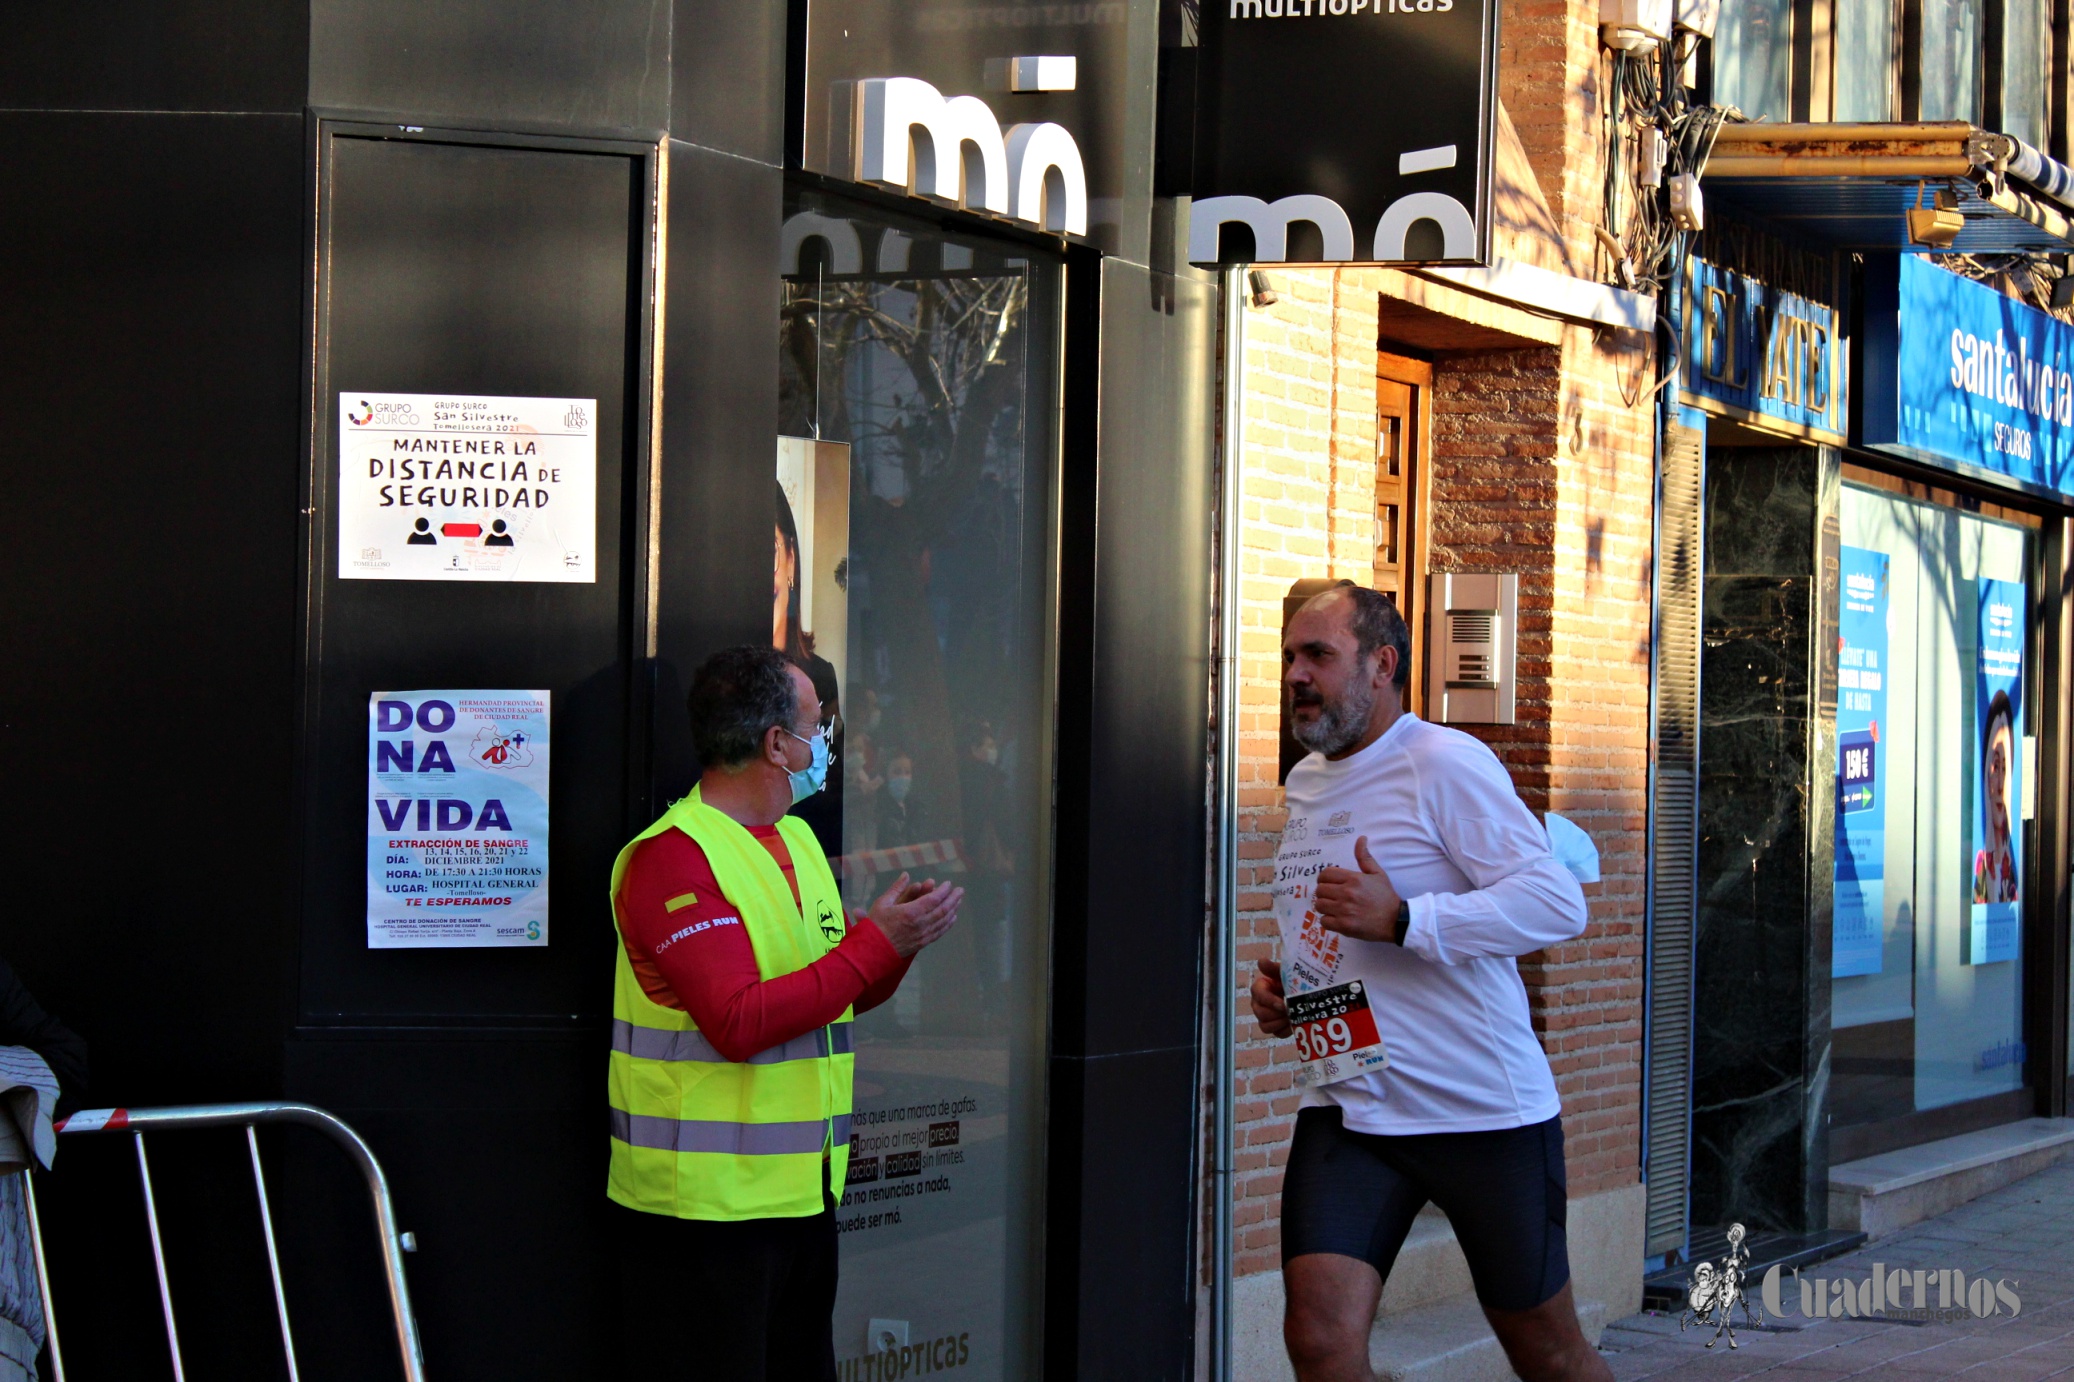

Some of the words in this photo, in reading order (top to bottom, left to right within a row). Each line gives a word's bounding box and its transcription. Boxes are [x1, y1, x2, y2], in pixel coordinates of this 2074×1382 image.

[1702, 284, 1748, 390] EL
[1756, 303, 1827, 413] YATE
[375, 403, 412, 414] GRUPO
[434, 402, 460, 410] GRUPO
[462, 402, 488, 410] SURCO
[375, 413, 420, 426] SURCO
[434, 411, 456, 421] San
[462, 412, 519, 423] Silvestre
[394, 438, 506, 455] MANTENER
[514, 441, 537, 456] LA
[1994, 421, 2031, 460] SEGUROS
[369, 458, 529, 482] DISTANCIA
[539, 468, 561, 483] DE
[379, 485, 549, 508] SEGURIDAD
[377, 699, 456, 733] DO
[377, 740, 456, 773] NA
[375, 799, 512, 832] VIDA
[389, 838, 463, 848] EXTRACCIÓN
[465, 840, 482, 848] DE
[483, 839, 528, 848] SANGRE
[386, 854, 409, 864] DÍA:
[424, 857, 483, 865] DICIEMBRE
[485, 856, 504, 864] 2021
[386, 870, 421, 879] HORA:
[425, 868, 439, 877] DE
[442, 868, 466, 877] 17:30
[468, 868, 477, 877] A
[478, 867, 503, 876] 21:30
[505, 867, 542, 876] HORAS
[386, 885, 428, 894] LUGAR:
[432, 880, 485, 889] HOSPITAL
[487, 879, 539, 888] GENERAL
[405, 898, 422, 907] TE
[426, 896, 512, 906] ESPERAMOS
[656, 939, 672, 954] CAA
[671, 919, 710, 943] PIELES
[713, 916, 739, 927] RUN
[1293, 962, 1320, 987] Pieles
[1296, 993, 1357, 1014] Silvestre
[1294, 1017, 1352, 1062] 369
[1365, 1055, 1384, 1065] RUN
[869, 1111, 885, 1127] que
[888, 1109, 904, 1122] una
[908, 1104, 936, 1119] marca
[939, 1100, 949, 1115] de
[952, 1096, 977, 1118] gafas.
[860, 1132, 889, 1154] propio
[892, 1130, 900, 1147] al
[903, 1128, 928, 1149] mejor
[886, 1152, 920, 1175] calidad
[922, 1152, 933, 1168] sin
[854, 1190, 866, 1204] no
[869, 1180, 914, 1202] renuncias
[917, 1182, 923, 1194] a
[925, 1175, 951, 1193] nada,
[836, 1214, 865, 1234] puede
[868, 1213, 882, 1229] ser
